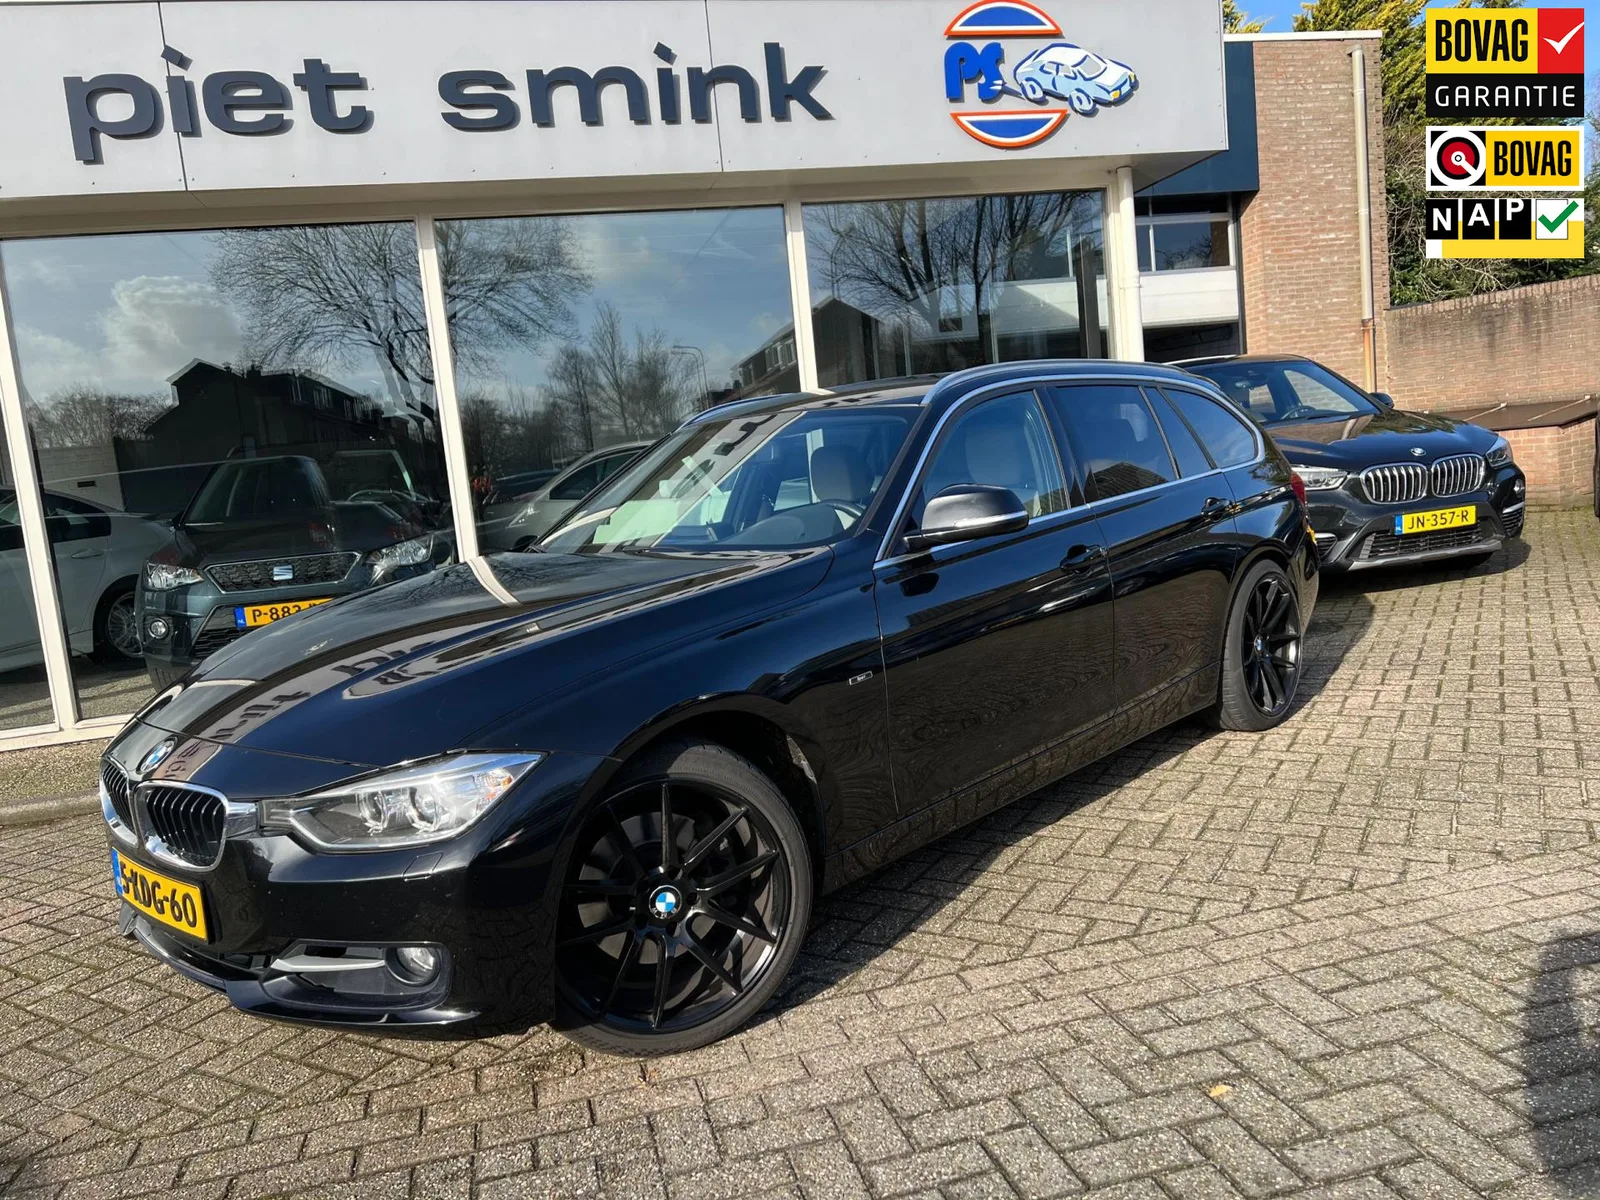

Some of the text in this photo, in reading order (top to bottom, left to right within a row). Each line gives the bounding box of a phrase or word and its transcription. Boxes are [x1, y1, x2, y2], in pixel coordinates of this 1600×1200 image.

[63, 42, 832, 161] piet smink
[1408, 510, 1468, 530] JN-357-R
[120, 860, 197, 928] 5-KDG-60
